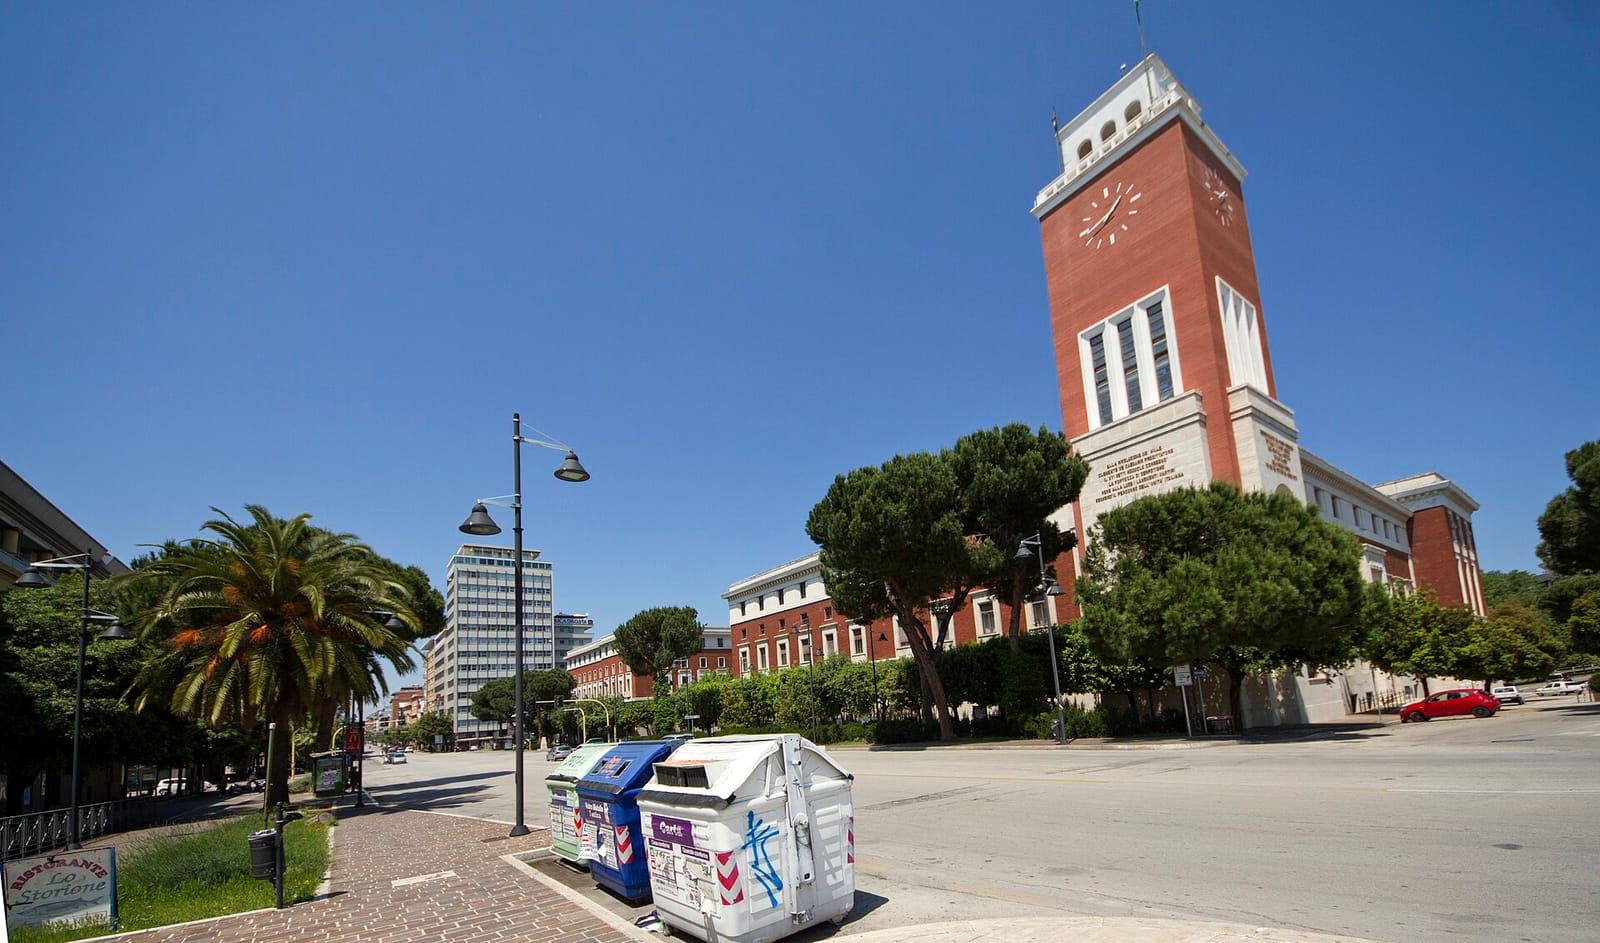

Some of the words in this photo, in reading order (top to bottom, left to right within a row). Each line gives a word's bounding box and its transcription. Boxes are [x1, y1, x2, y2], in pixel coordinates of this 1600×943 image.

[10, 858, 108, 890] RISTORANTE
[46, 872, 76, 886] Lo
[19, 881, 106, 902] Storione
